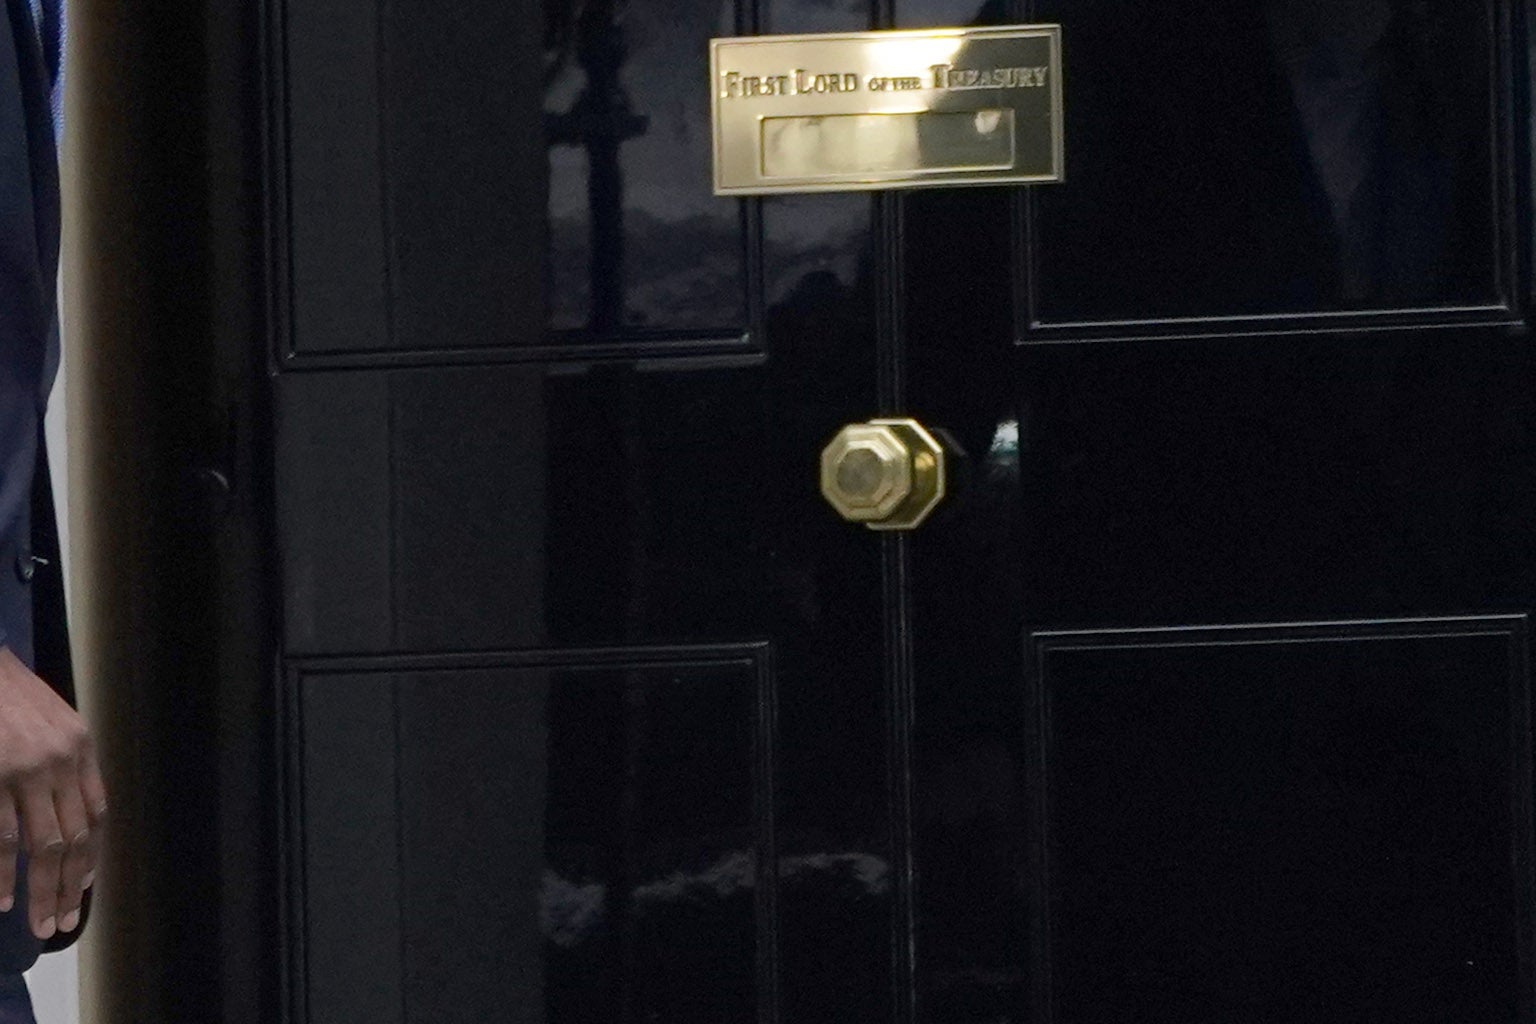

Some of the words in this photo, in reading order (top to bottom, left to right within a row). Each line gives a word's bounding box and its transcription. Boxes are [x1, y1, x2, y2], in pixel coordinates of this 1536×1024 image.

[721, 71, 789, 98] FIRST
[792, 69, 859, 94] LORD
[868, 78, 888, 91] OF
[889, 76, 922, 90] THE
[930, 63, 1048, 89] TREASURY
